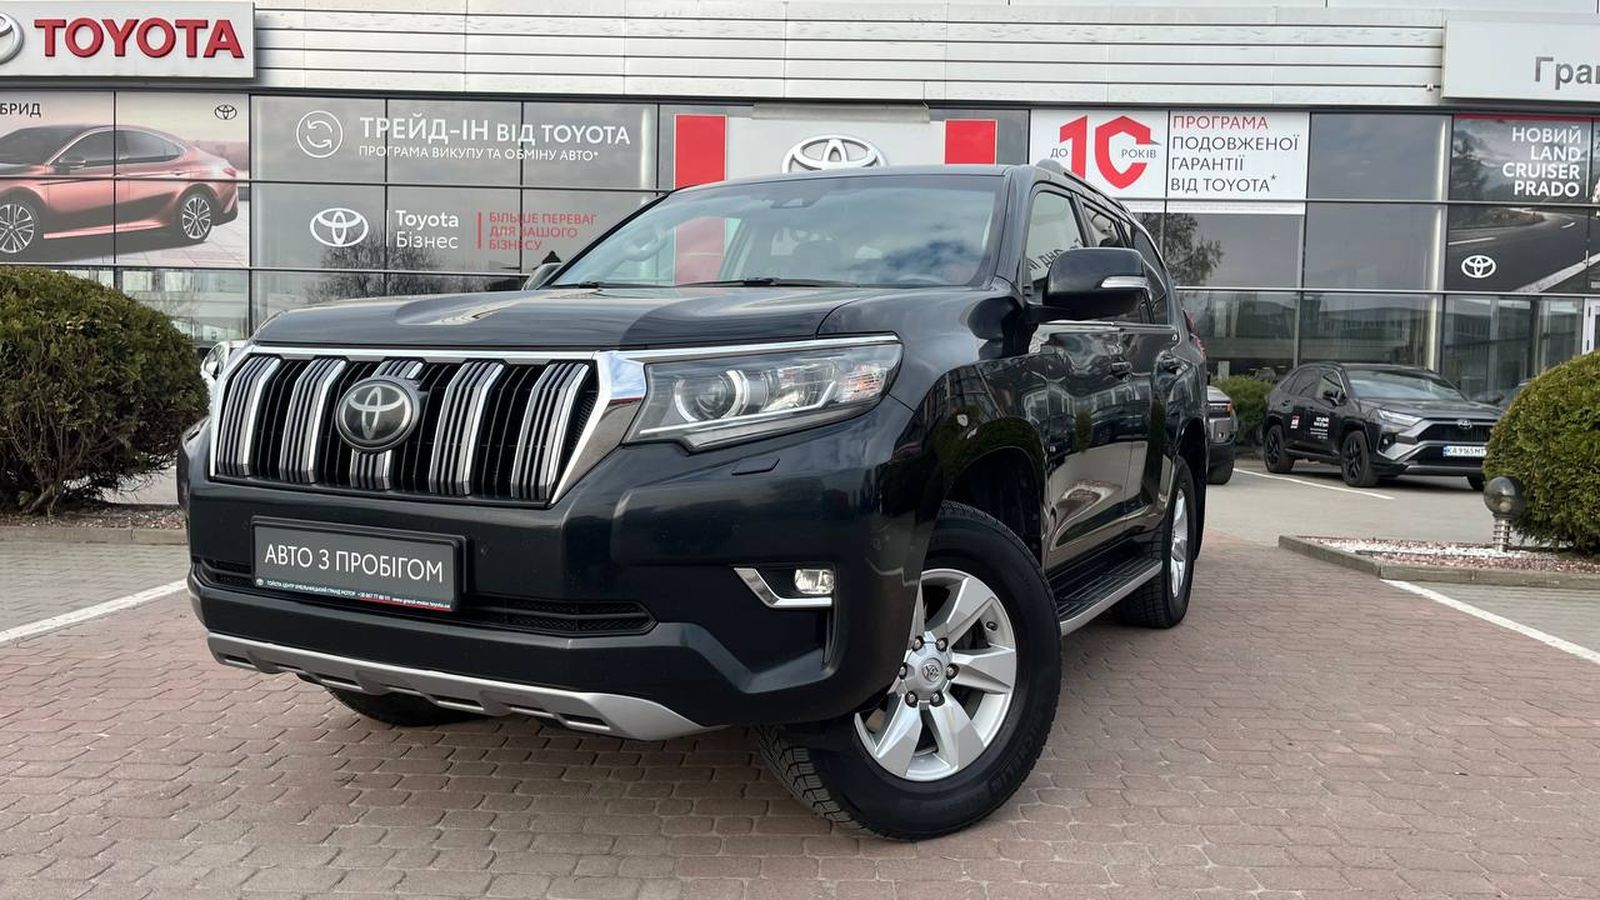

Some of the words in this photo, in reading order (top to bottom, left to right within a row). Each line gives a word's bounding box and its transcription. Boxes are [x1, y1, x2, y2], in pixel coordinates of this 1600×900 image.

[34, 17, 244, 59] TOYOTA
[1534, 56, 1600, 91] Гра
[359, 113, 489, 144] ТРЕЙД-ІН
[497, 123, 536, 146] ВІД
[541, 124, 631, 145] TOYOTA
[1173, 115, 1269, 130] ПРОГРАМА
[1172, 133, 1300, 153] ПОДОВЖЕНОЇ
[1512, 126, 1582, 144] НОВИЙ
[359, 145, 429, 158] ПРОГРАМА
[432, 147, 484, 160] ВИКУПУ
[486, 149, 501, 160] ТА
[504, 148, 557, 161] ОБМІНУ
[1050, 148, 1068, 159] ДО
[1121, 148, 1157, 159] РОКІВ
[1530, 146, 1581, 162] LAND
[1171, 154, 1245, 172] ГАРАНТІЇ
[1502, 162, 1581, 180] CRUISER
[1170, 177, 1199, 194] ВІД
[1513, 181, 1581, 198] PRADO
[396, 210, 459, 231] Toyota
[542, 213, 598, 225] ПЕРЕВАГ
[396, 231, 459, 249] Бізнес
[489, 226, 516, 238] ДЛЯ
[265, 543, 313, 568] АВТО
[318, 549, 330, 570] З
[335, 550, 443, 583] ПРОБІГОМ
